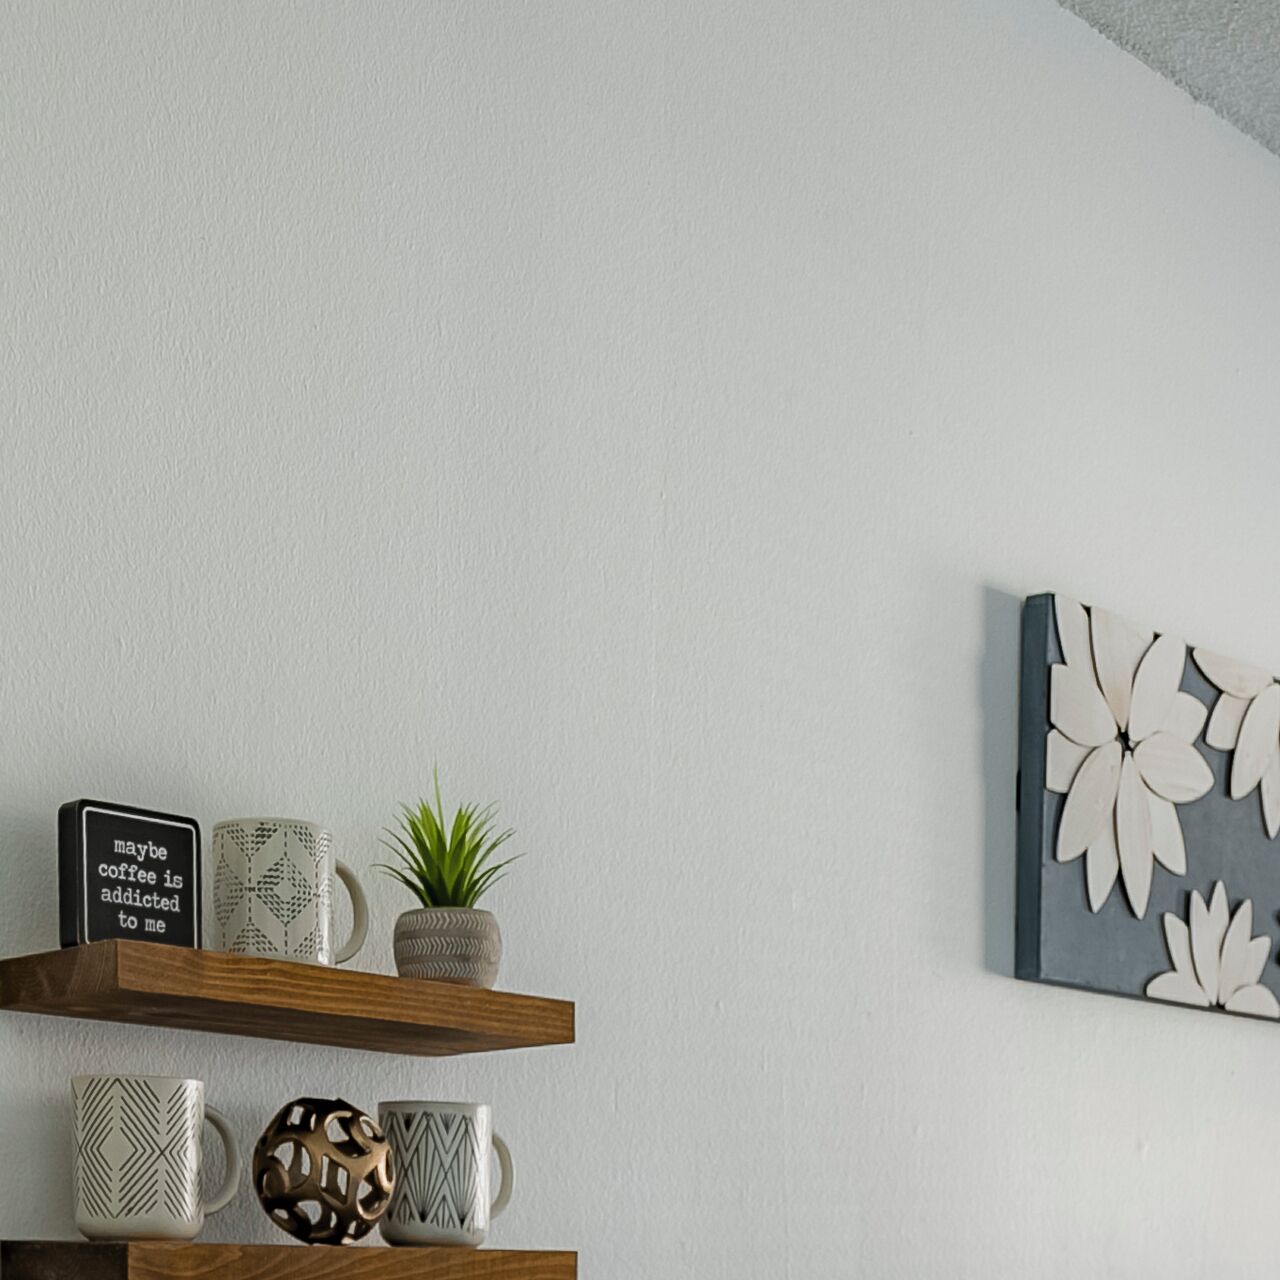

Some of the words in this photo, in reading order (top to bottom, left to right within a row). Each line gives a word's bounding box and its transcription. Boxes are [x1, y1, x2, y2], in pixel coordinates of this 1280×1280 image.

[113, 839, 168, 861] maybe
[98, 863, 157, 885] coffee
[163, 869, 183, 889] is
[100, 886, 181, 912] addicted
[118, 910, 138, 929] to
[144, 918, 166, 933] me
